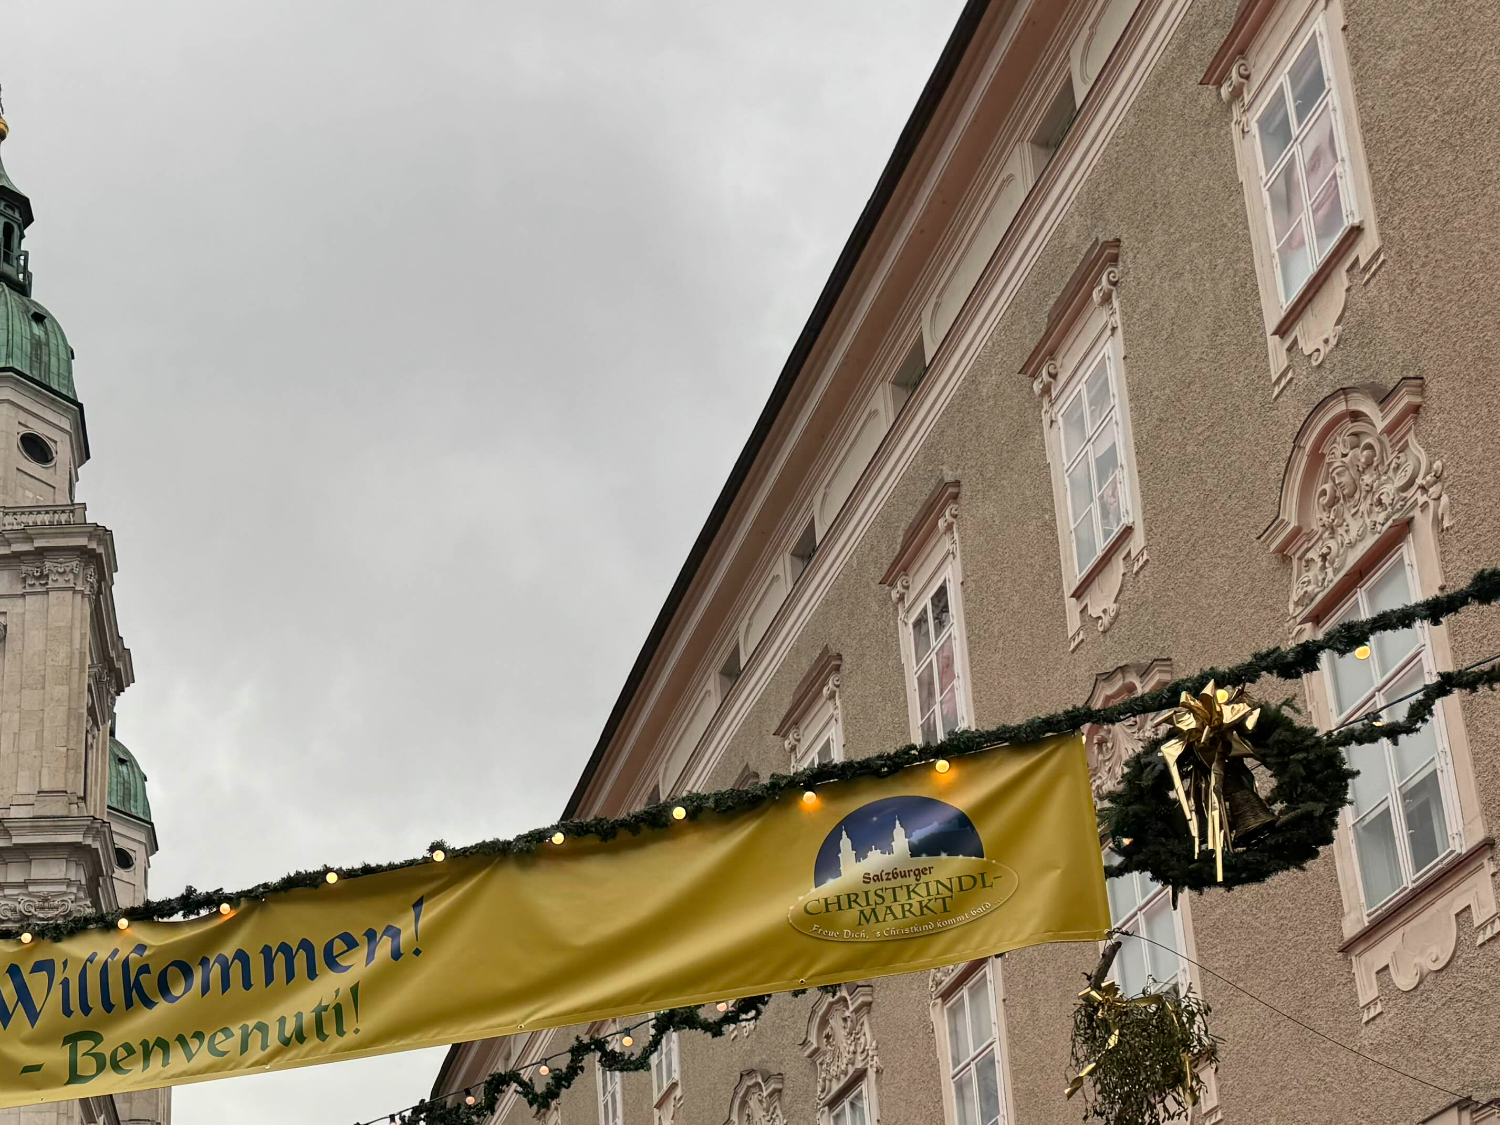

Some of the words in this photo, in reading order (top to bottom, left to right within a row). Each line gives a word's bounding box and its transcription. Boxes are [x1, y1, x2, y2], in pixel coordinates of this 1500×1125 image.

[803, 871, 1003, 917] CHRISTKINDL-
[862, 865, 934, 885] Salzburger
[856, 895, 955, 927] MARKT
[61, 981, 363, 1086] Benvenuti!
